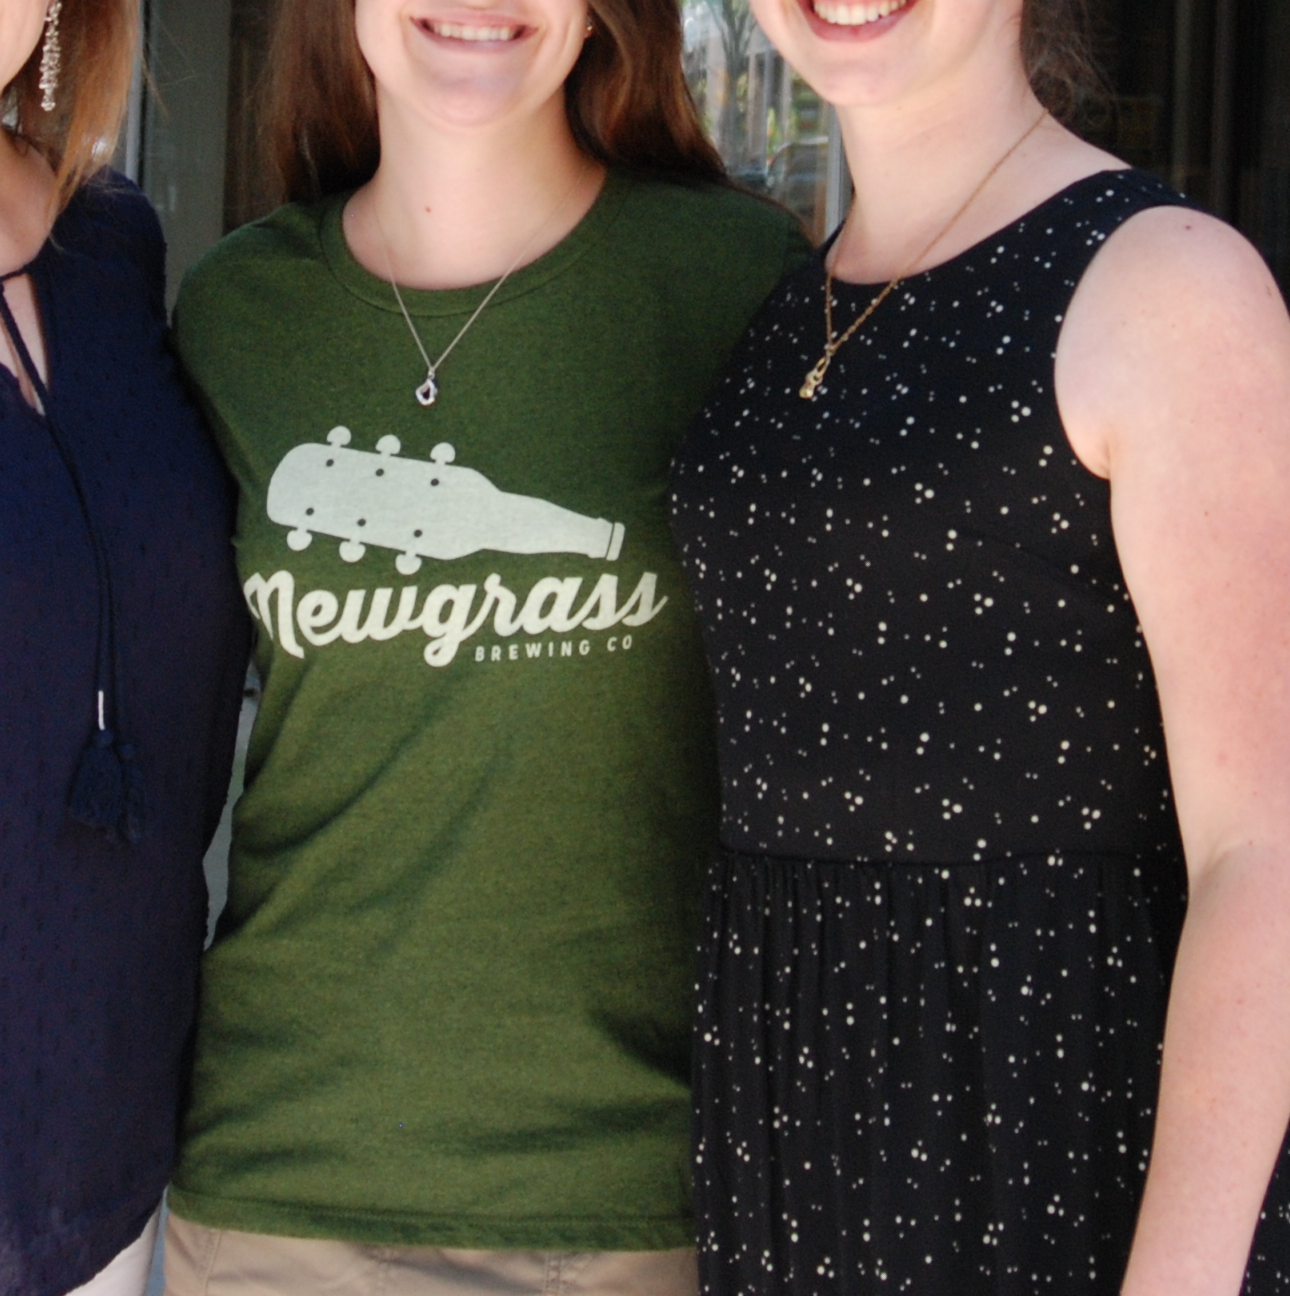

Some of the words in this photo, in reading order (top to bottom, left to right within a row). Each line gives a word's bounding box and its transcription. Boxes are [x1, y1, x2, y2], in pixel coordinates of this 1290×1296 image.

[243, 570, 668, 667] Newgrass
[475, 640, 591, 663] BREWING
[607, 635, 633, 653] CO
